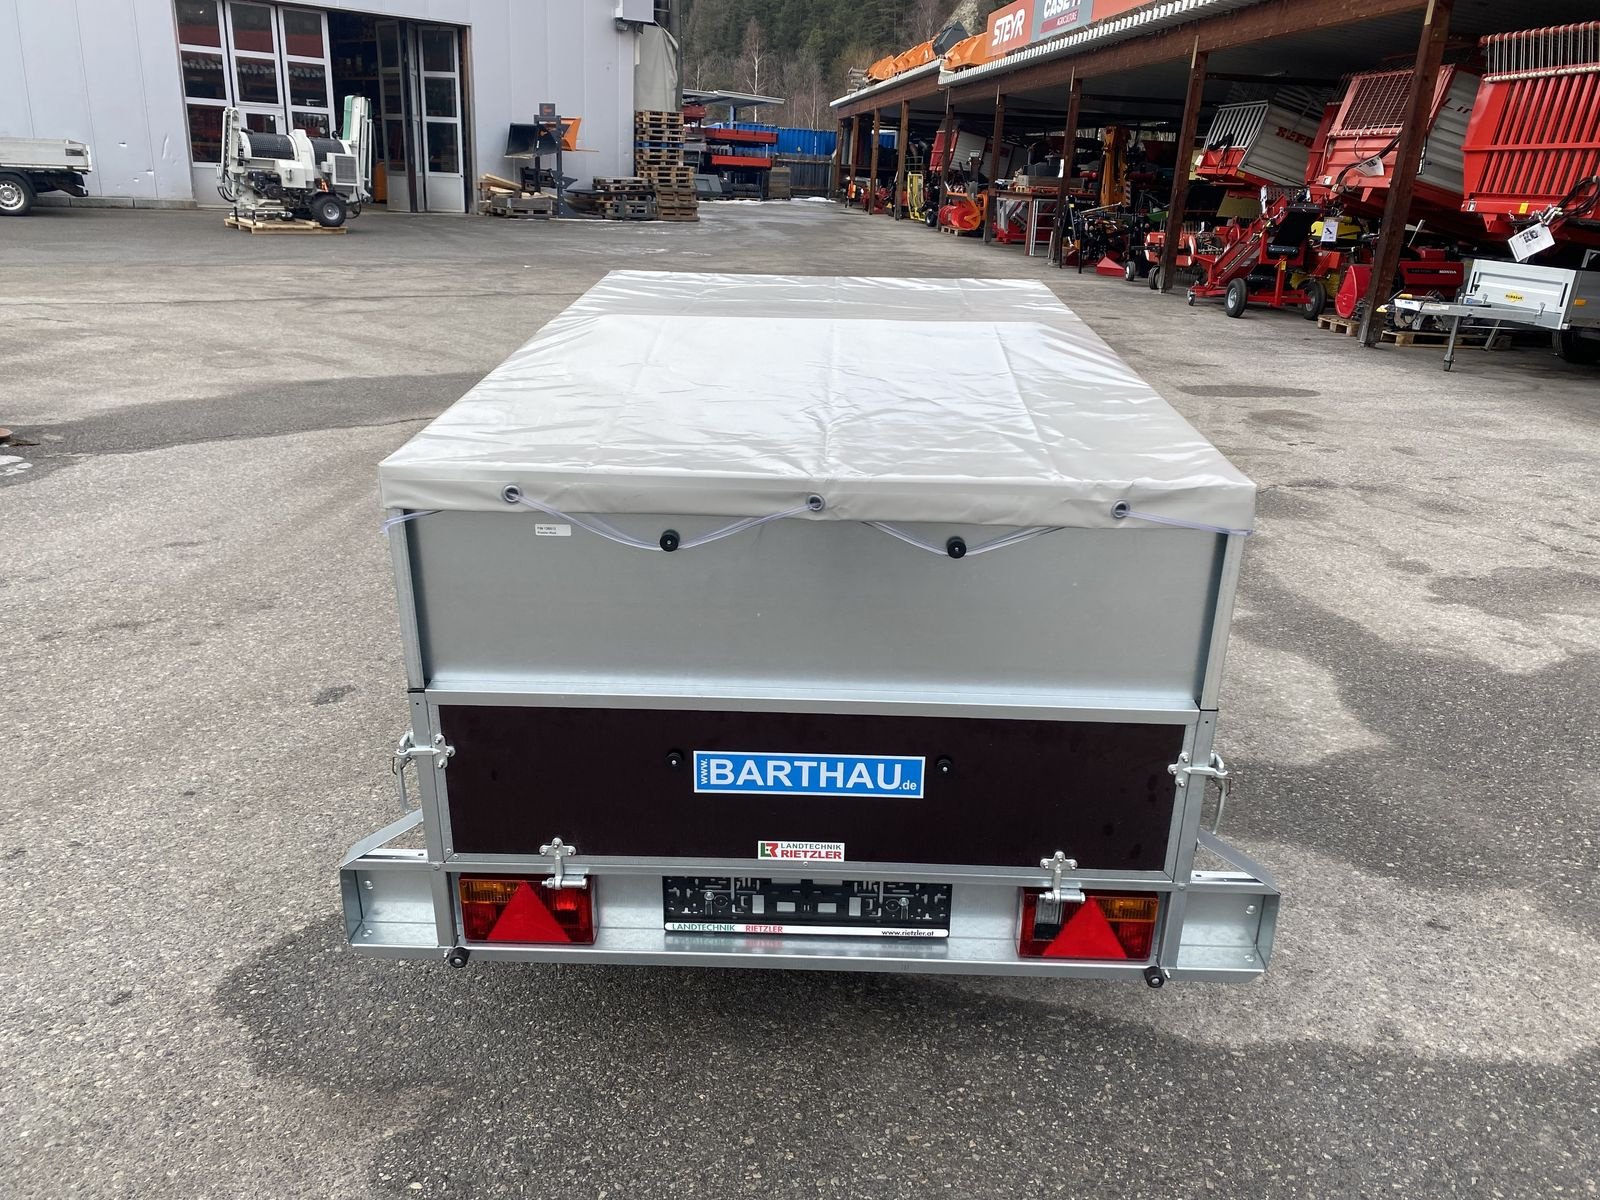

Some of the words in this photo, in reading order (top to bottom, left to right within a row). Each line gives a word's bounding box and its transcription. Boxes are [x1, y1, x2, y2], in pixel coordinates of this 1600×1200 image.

[992, 8, 1025, 47] STEYR
[781, 849, 842, 860] RIETZLER
[672, 923, 735, 932] LANDTECHNIK
[745, 924, 783, 933] RIETZLER
[881, 928, 934, 937] www.rietzler.at
